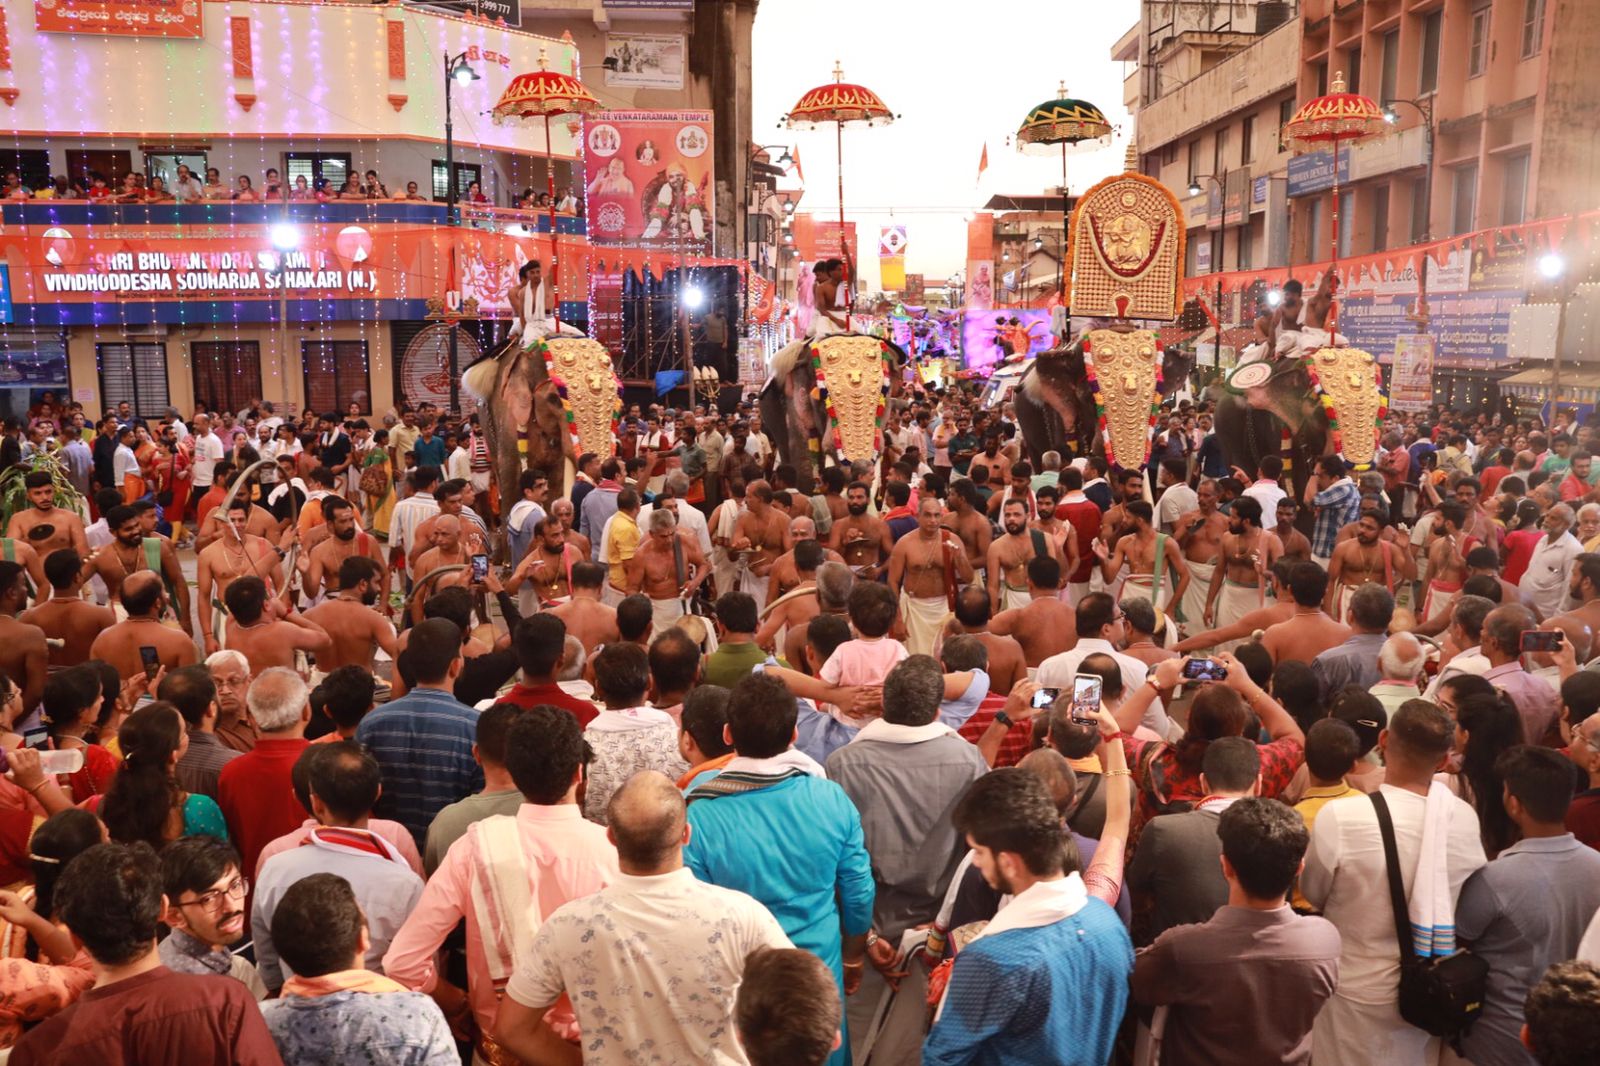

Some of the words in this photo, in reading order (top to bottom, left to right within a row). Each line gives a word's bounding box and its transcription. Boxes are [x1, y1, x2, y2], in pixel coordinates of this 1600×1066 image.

[497, 3, 510, 14] 777
[613, 112, 678, 121] VENKATARAMANA
[680, 113, 709, 122] TEMPLE
[95, 252, 134, 271] SHRI
[138, 250, 254, 271] BHUVANENDRA
[43, 272, 173, 292] VIVIDHODDESHA
[176, 271, 261, 290] SOUHARDA
[264, 270, 343, 289] SAHAKARI
[346, 270, 376, 292] (N.)
